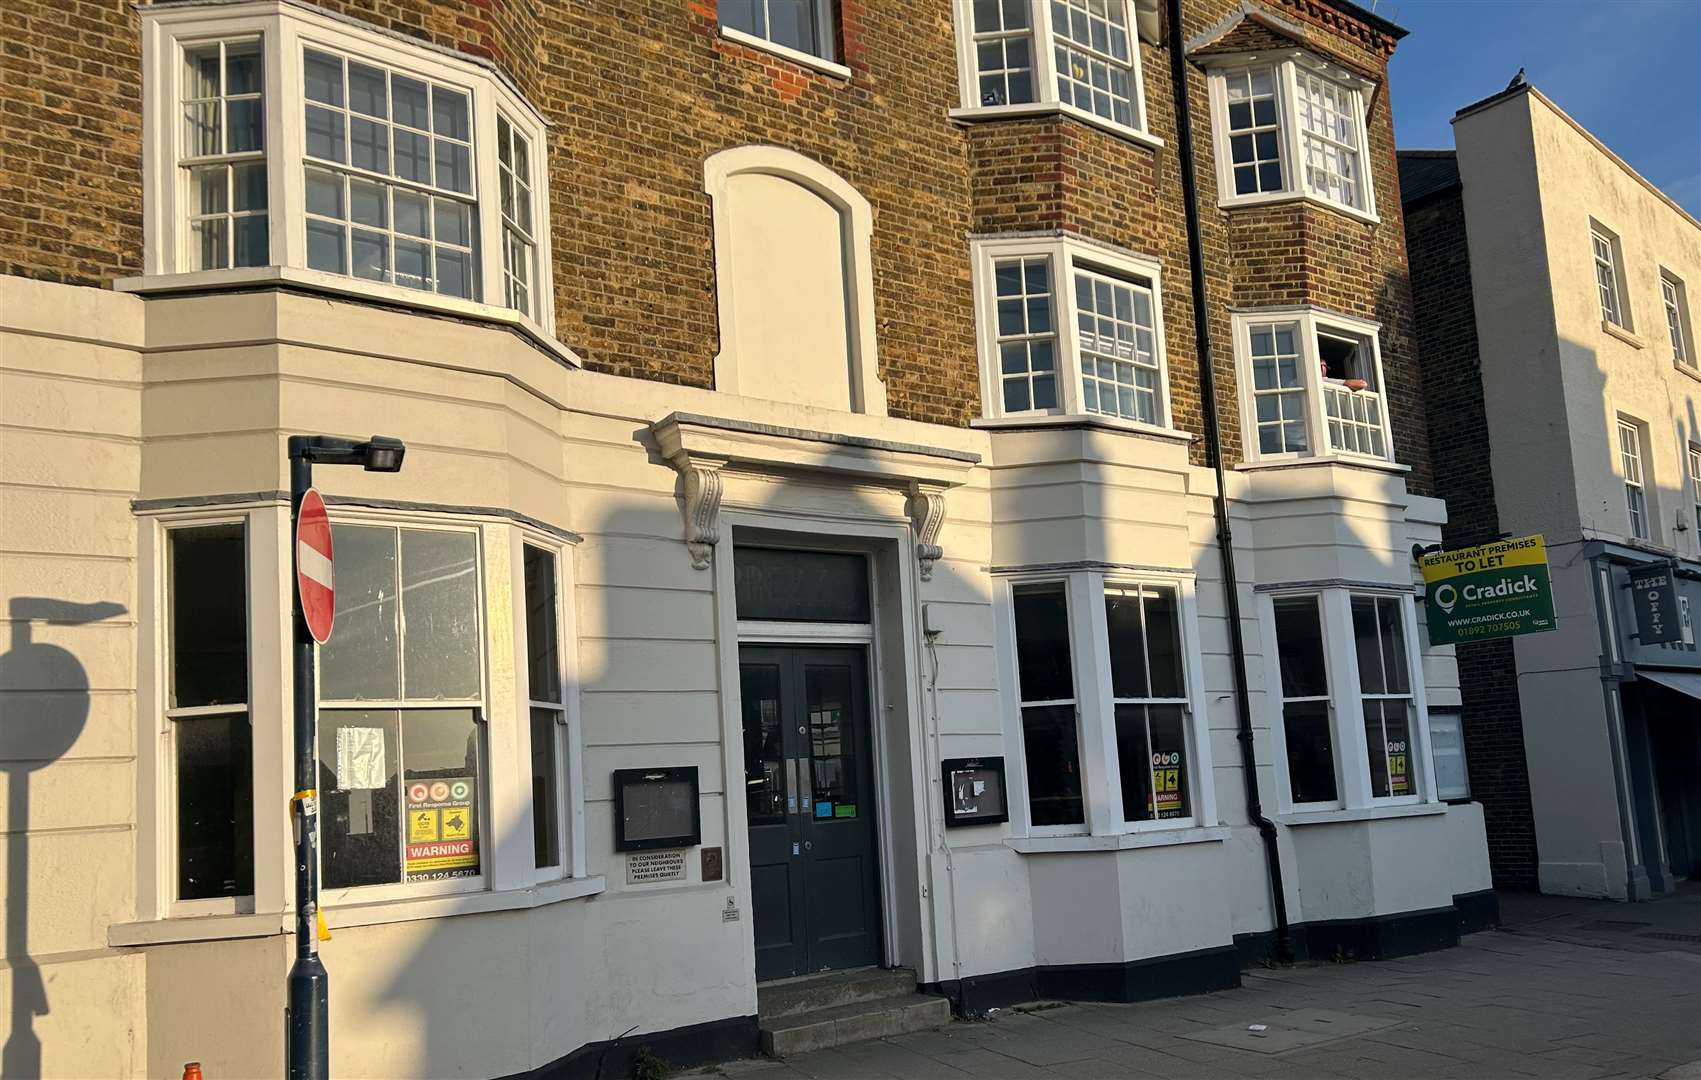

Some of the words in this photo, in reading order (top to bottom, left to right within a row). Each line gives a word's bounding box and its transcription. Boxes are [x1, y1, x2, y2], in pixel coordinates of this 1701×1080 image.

[1424, 548, 1486, 567] RESTAURANT
[1488, 539, 1537, 556] PREMISES
[1455, 560, 1476, 573] TO
[1479, 554, 1505, 569] LET
[1462, 574, 1538, 601] Cradick
[1634, 576, 1667, 589] THE
[1447, 609, 1531, 627] WWW.CRADICK.CO.UK
[1458, 625, 1486, 637] 01892
[1487, 620, 1521, 634] 707505
[1157, 793, 1178, 801] ARNING
[411, 843, 469, 857] WARNING
[639, 853, 681, 861] CONSIDERATION
